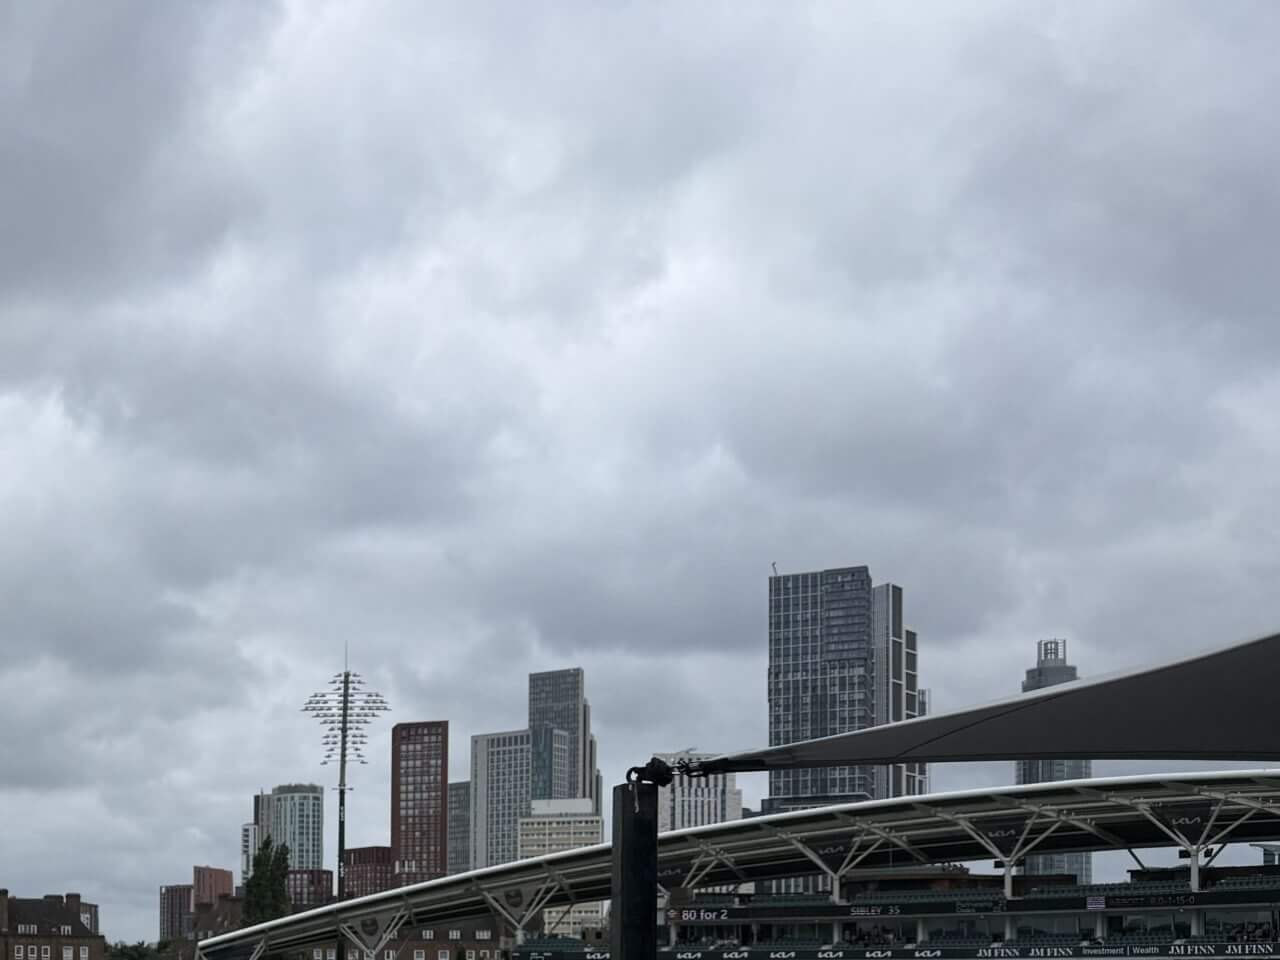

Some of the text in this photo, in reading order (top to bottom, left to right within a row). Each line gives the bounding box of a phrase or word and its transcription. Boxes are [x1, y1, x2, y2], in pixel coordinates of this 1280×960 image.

[681, 909, 728, 920] 80 for 2
[993, 948, 1020, 957] FINN
[1046, 947, 1073, 957] FINN
[1082, 946, 1160, 956] Investment Wealth
[1168, 945, 1216, 955] JM FINN
[1225, 943, 1274, 954] JM FINN
